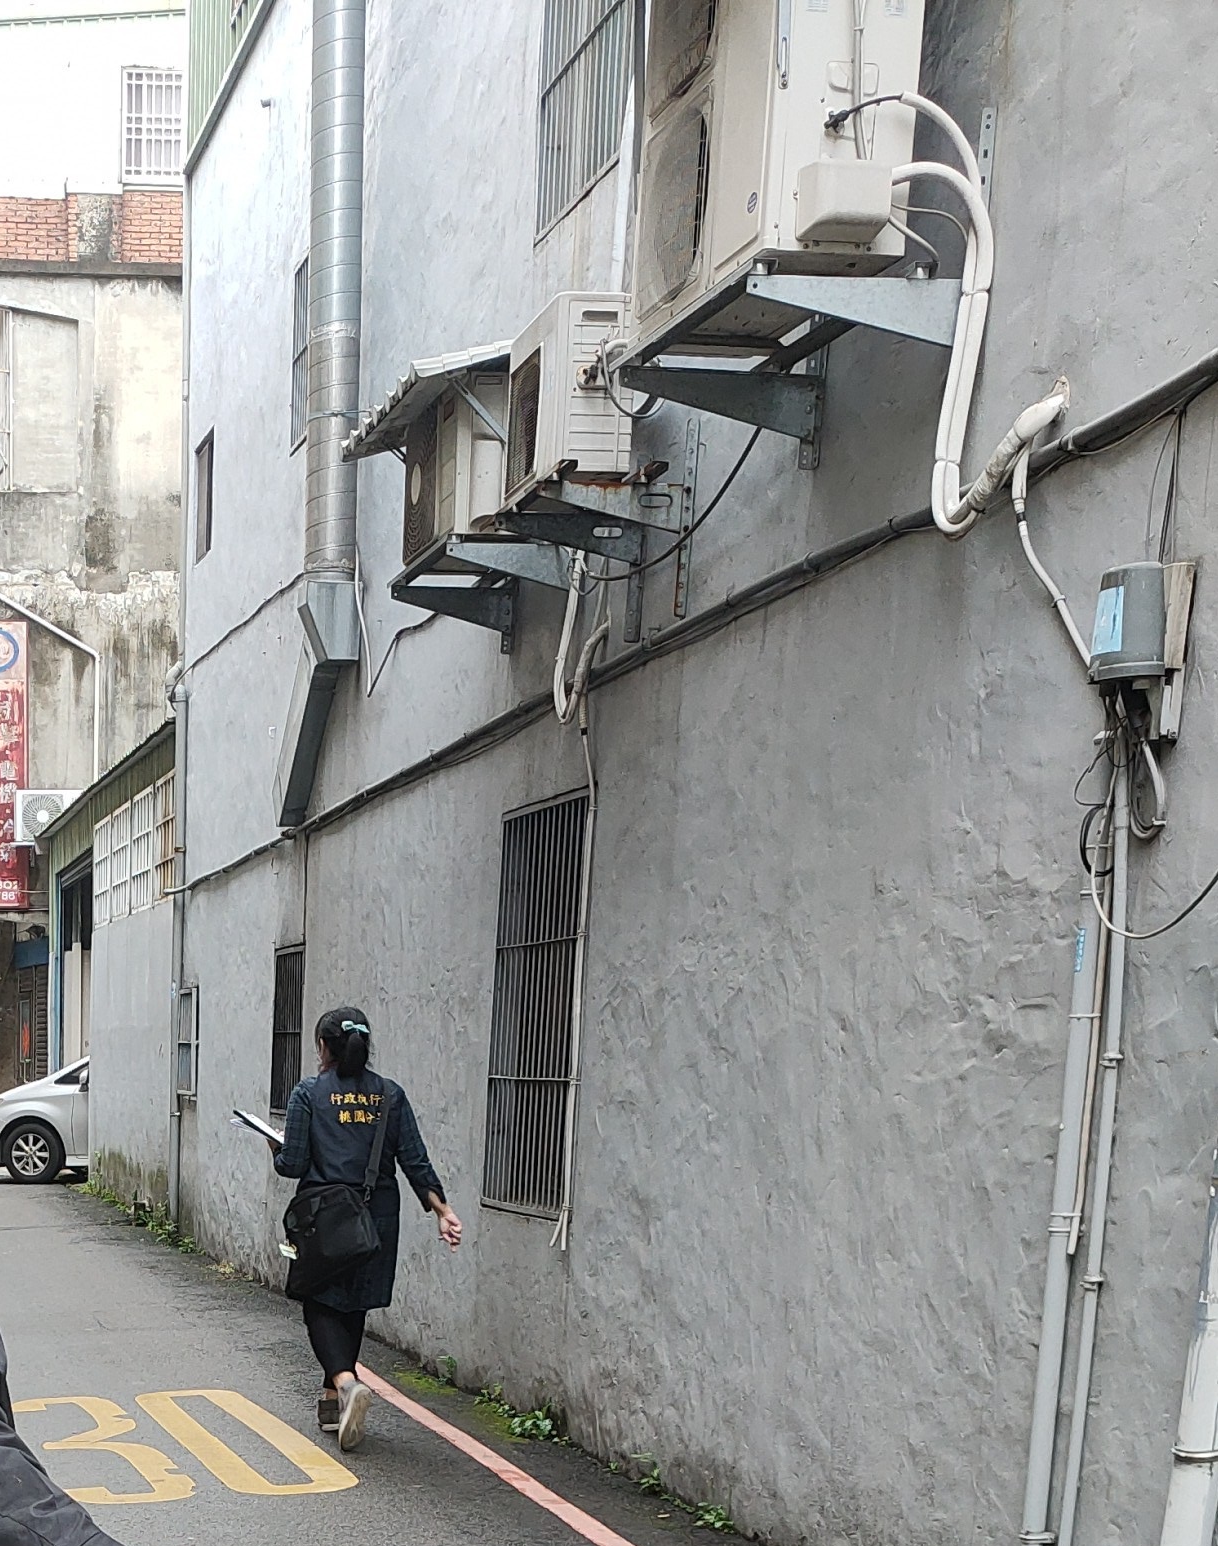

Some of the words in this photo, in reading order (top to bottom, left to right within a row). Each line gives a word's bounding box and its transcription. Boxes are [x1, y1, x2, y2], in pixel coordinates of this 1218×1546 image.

[330, 1092, 385, 1106] 行政執行
[13, 1389, 360, 1504] 30
